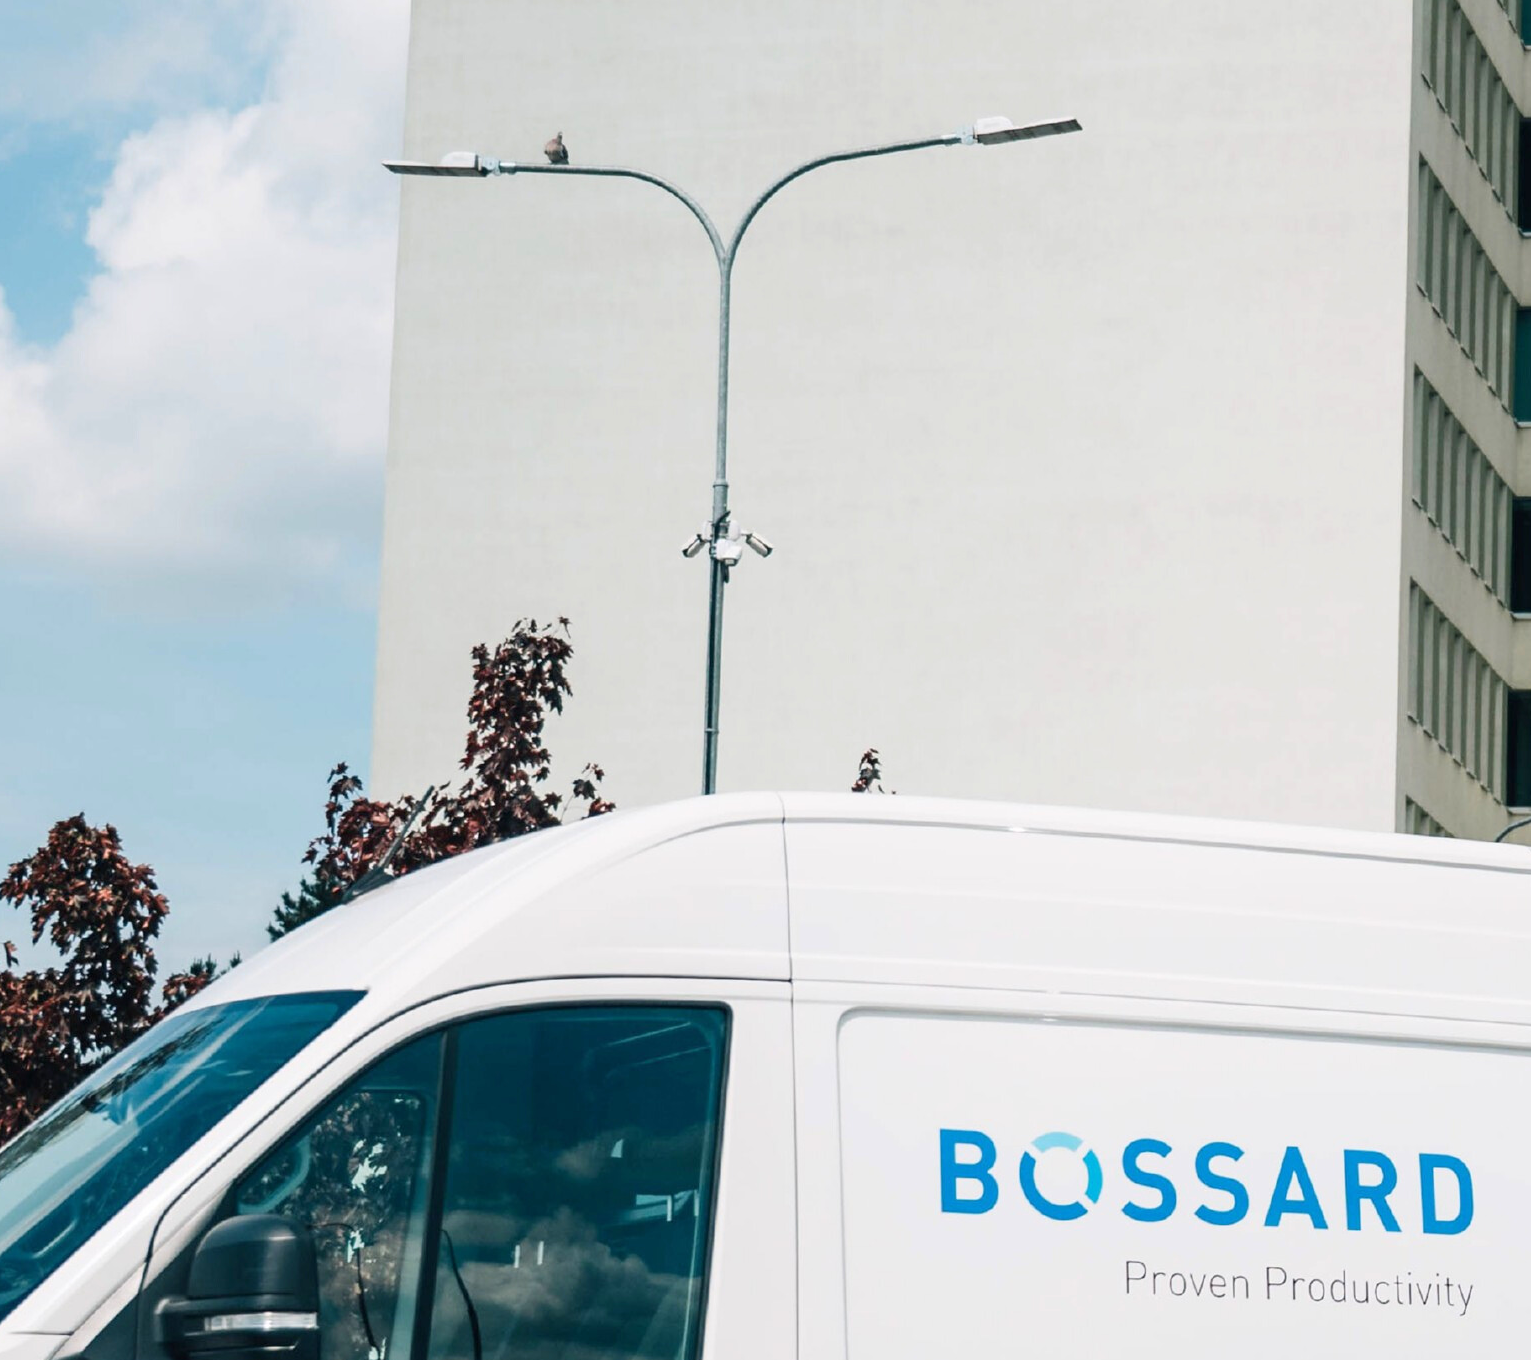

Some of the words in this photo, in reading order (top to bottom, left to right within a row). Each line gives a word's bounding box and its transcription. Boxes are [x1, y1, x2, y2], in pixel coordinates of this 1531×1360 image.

[939, 1128, 1474, 1236] BOSSARD
[1125, 1260, 1249, 1299] Proven
[1265, 1266, 1474, 1316] Productivity
